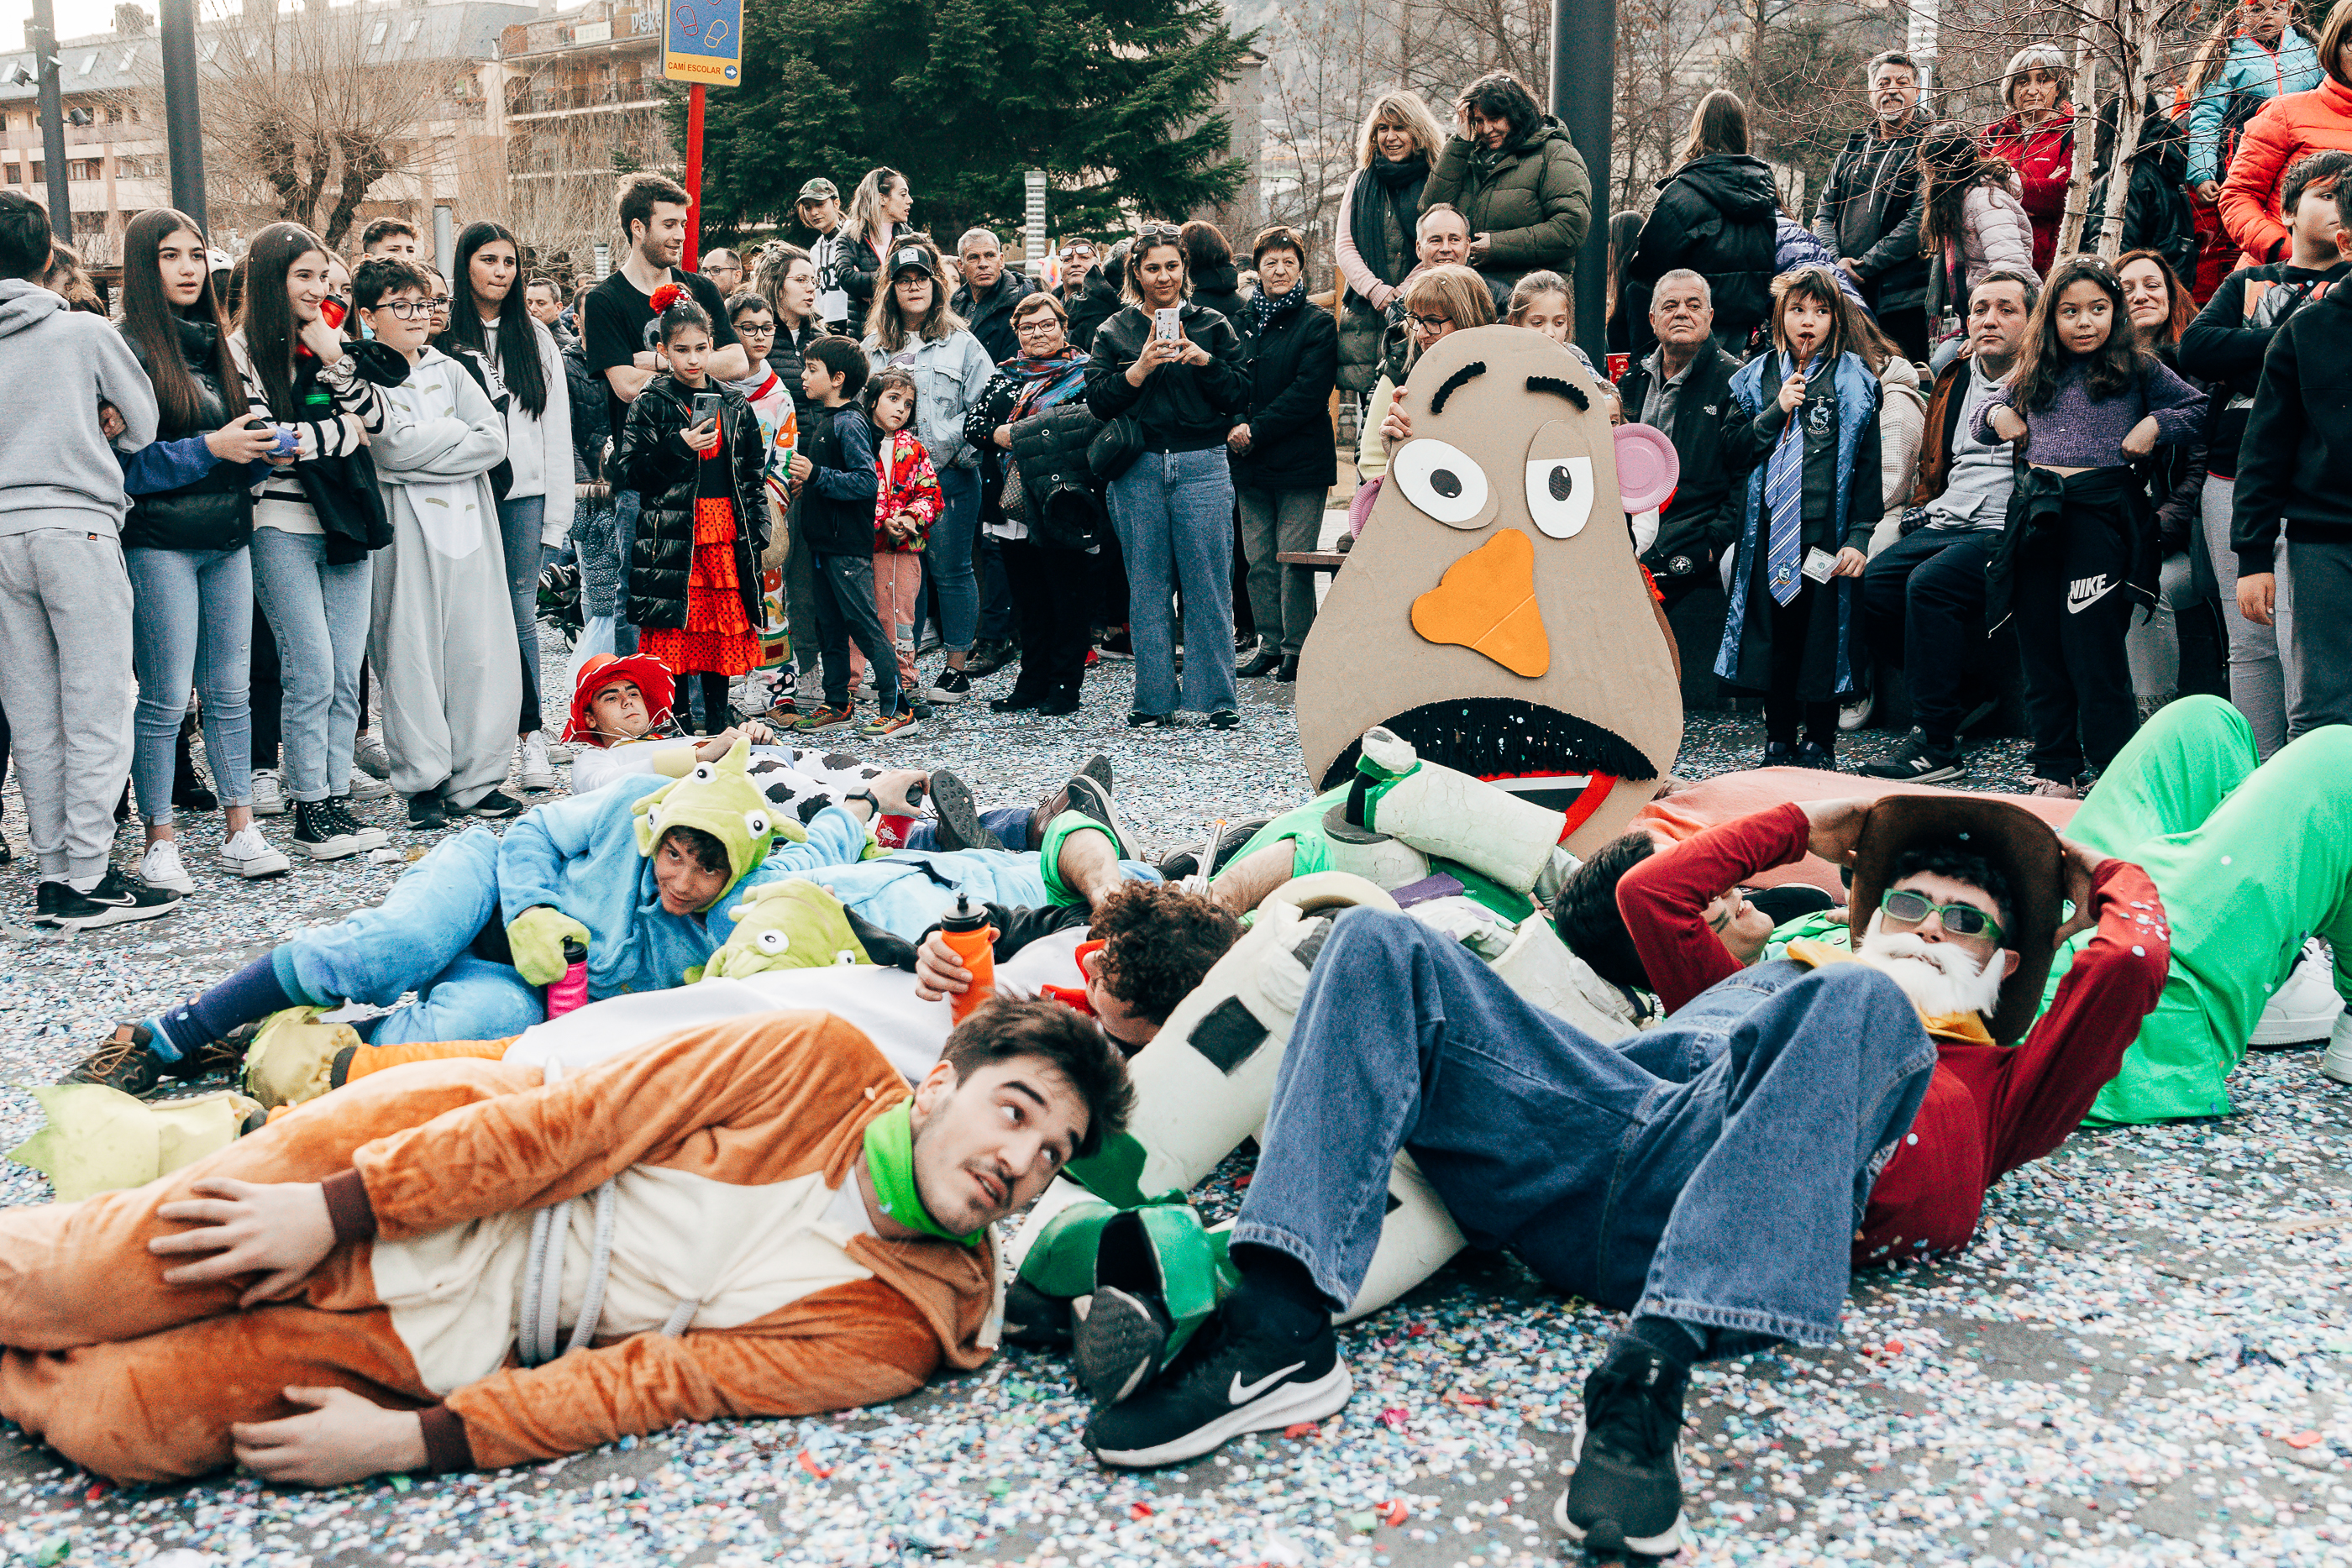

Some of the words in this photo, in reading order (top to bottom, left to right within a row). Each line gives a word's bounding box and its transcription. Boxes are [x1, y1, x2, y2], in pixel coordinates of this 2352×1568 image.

[580, 27, 606, 39] HOTEL
[668, 61, 685, 71] CAMÍ
[687, 64, 721, 74] ESCOLAR
[2070, 574, 2107, 599] NIKE
